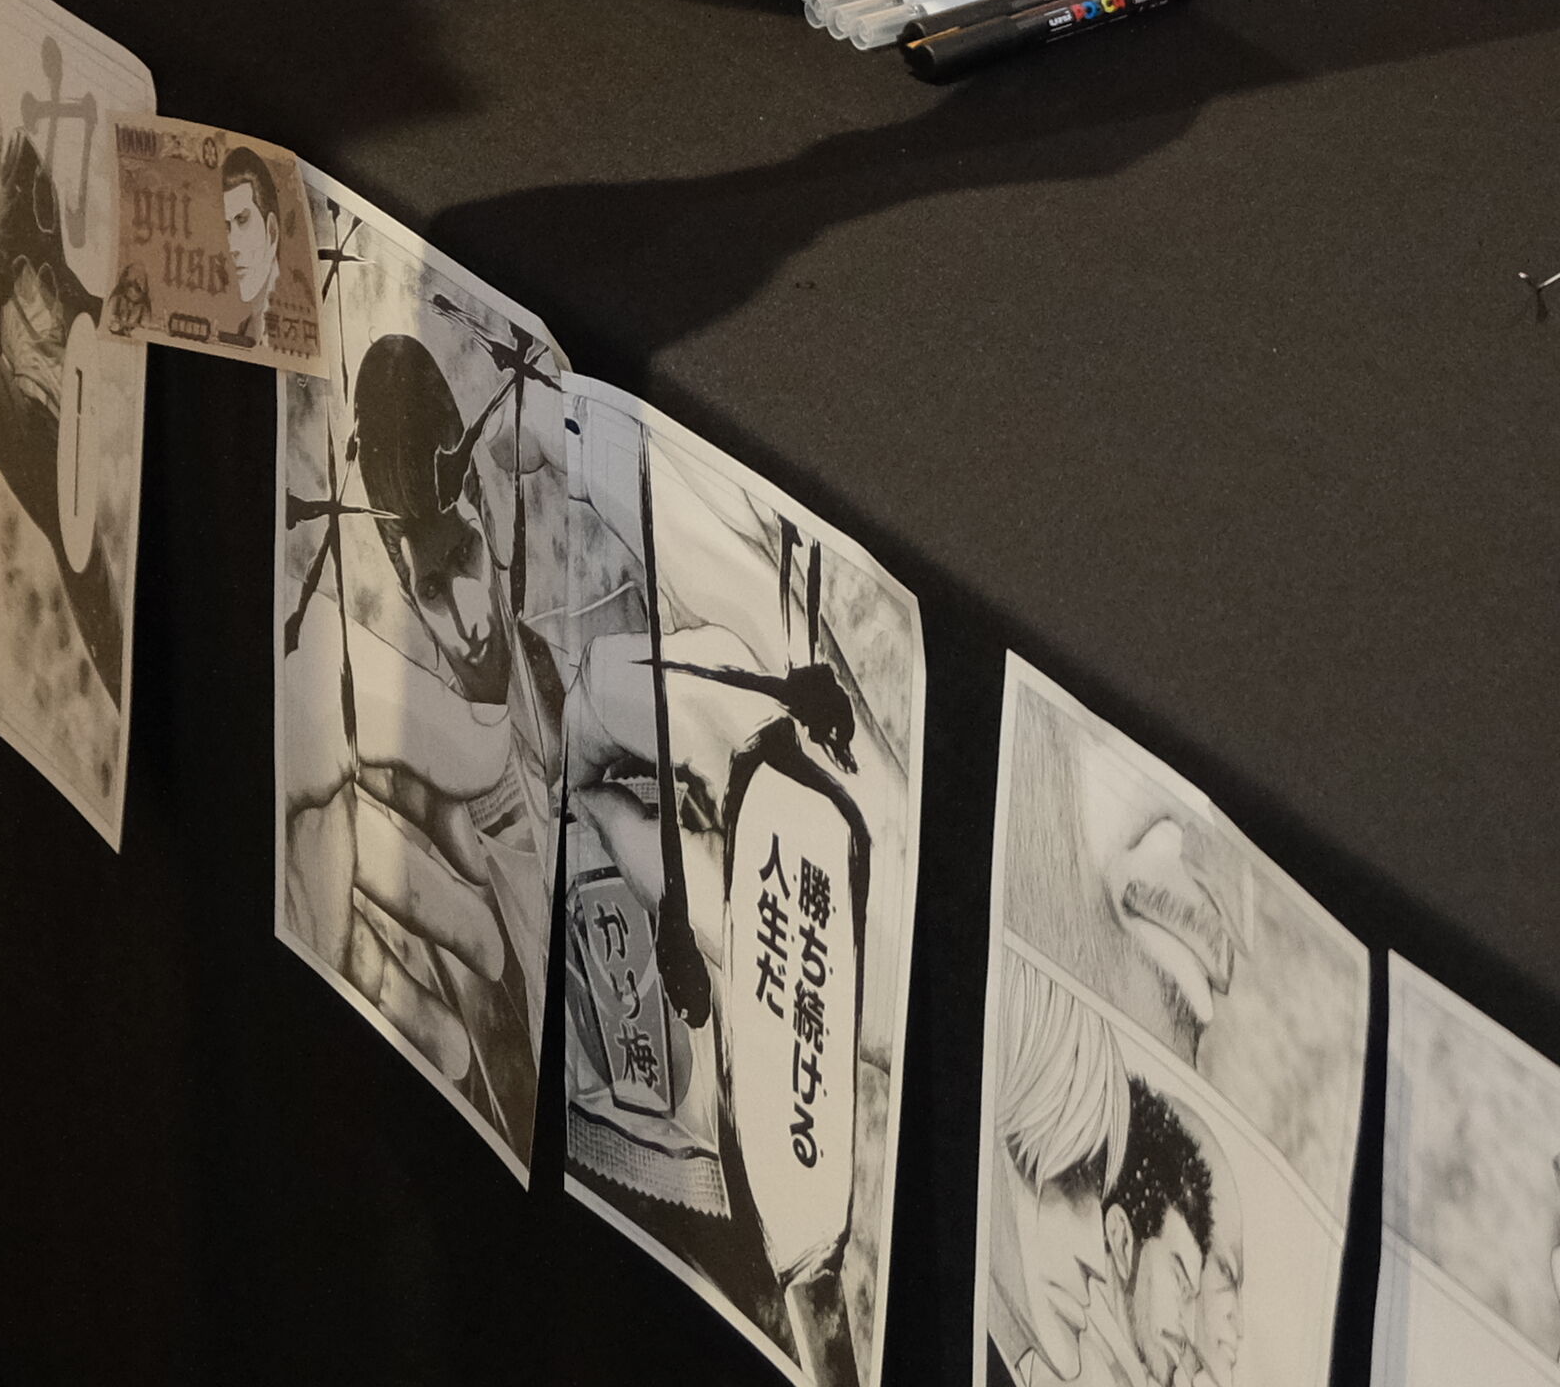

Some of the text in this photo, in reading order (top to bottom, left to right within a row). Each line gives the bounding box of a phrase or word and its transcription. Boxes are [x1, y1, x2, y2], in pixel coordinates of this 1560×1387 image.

[593, 899, 659, 1090] かり梅
[755, 832, 791, 1020] 人生だ
[789, 855, 832, 1169] 勝ち続ける
